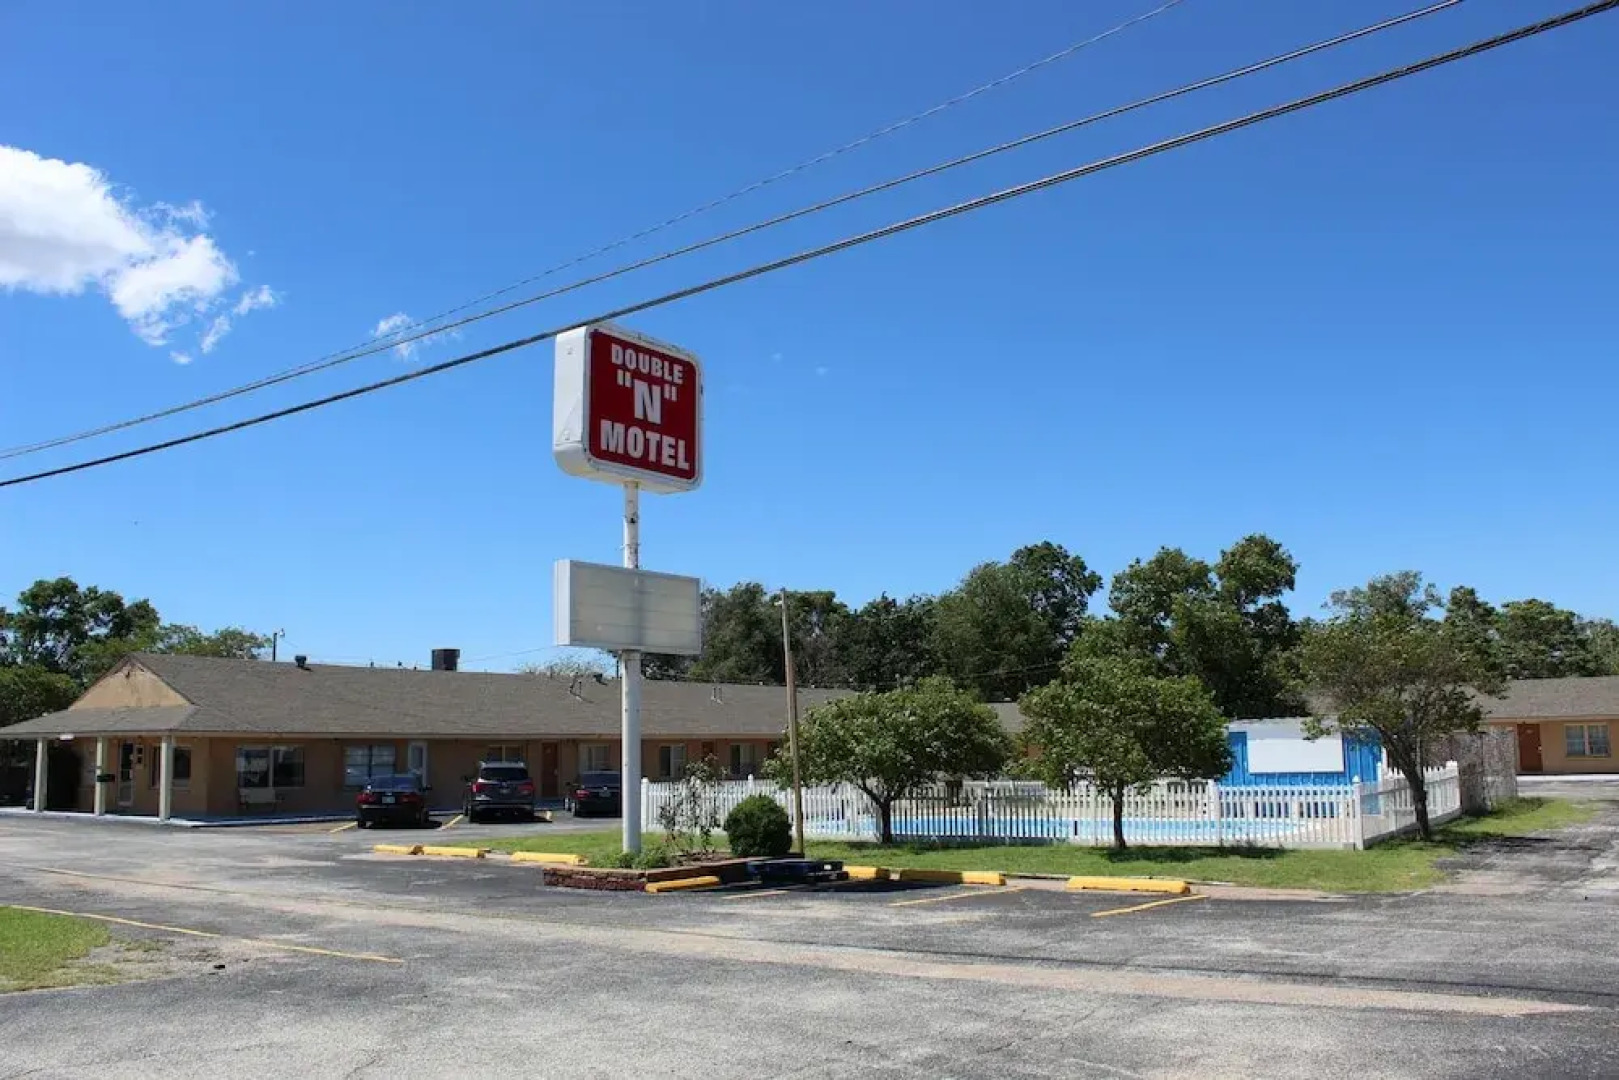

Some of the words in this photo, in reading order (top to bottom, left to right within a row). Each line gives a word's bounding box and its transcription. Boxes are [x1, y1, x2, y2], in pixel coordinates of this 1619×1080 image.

[611, 343, 683, 385] DOUBLE
[617, 369, 677, 425] "N"
[600, 419, 689, 470] MOTEL
